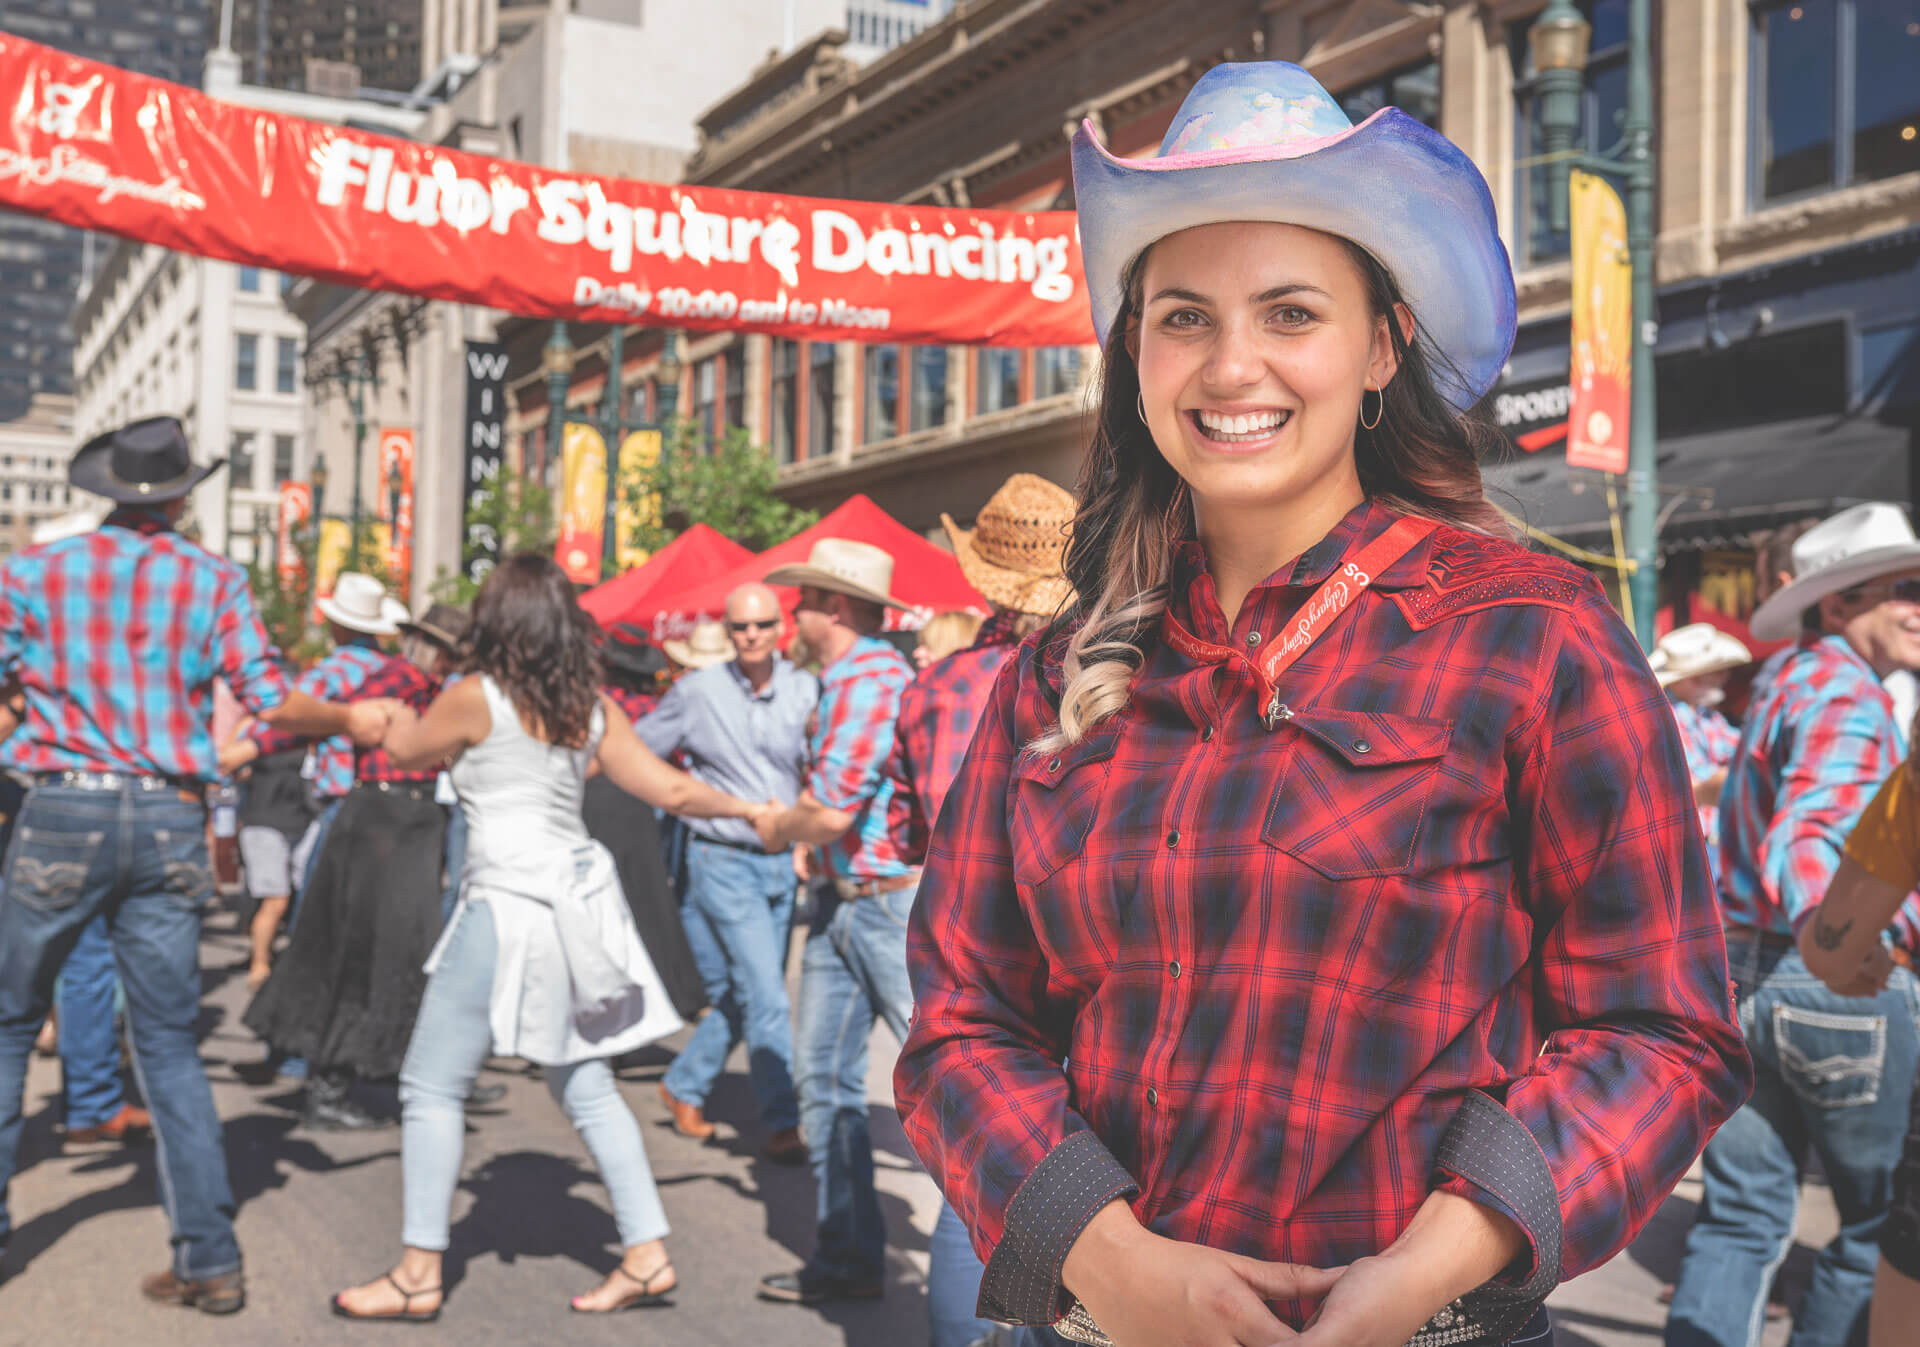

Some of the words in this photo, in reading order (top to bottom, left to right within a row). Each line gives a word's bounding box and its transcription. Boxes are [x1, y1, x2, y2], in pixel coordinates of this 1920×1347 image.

[316, 138, 529, 235] Fluor
[538, 180, 800, 273] Square
[812, 209, 1074, 302] Dancing
[574, 276, 651, 316] Daily
[656, 286, 738, 319] 10:00
[739, 299, 787, 323] am
[788, 299, 818, 325] to
[820, 298, 891, 329] Noon
[1308, 581, 1349, 625] Calgary
[1265, 618, 1313, 678] Stampede
